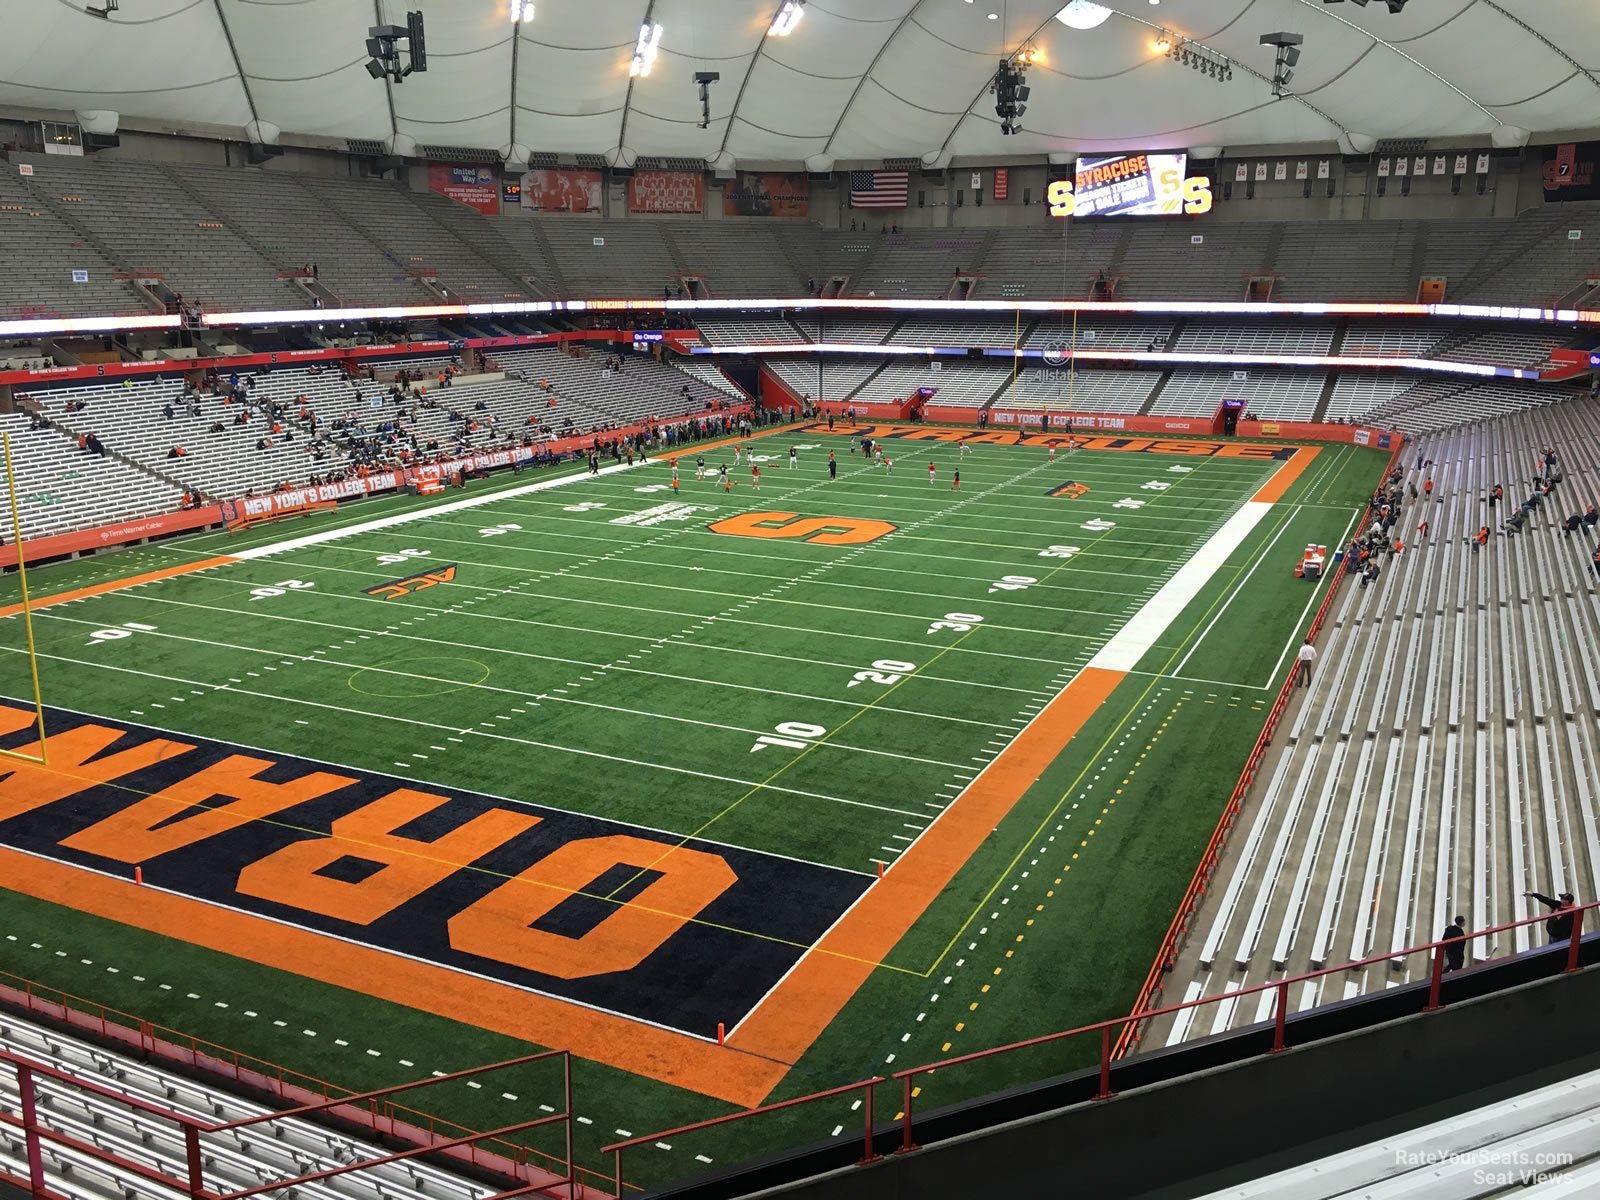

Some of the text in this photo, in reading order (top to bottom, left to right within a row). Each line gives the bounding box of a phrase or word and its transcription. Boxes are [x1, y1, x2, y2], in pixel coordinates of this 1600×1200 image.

[453, 167, 475, 175] United
[462, 175, 475, 183] Way
[1075, 155, 1146, 188] SYRACUSE
[1561, 165, 1568, 175] 7
[1159, 170, 1181, 194] S
[1048, 180, 1075, 216] S
[1184, 176, 1213, 215] S
[587, 301, 627, 309] SYRACUSE
[97, 365, 104, 376] S
[1034, 369, 1079, 380] Allstate
[994, 413, 1015, 423] NEW
[1098, 417, 1125, 429] TEAM
[803, 423, 1284, 459] SYRACUSE
[475, 452, 510, 470] COLLEGE
[512, 447, 533, 462] TEAM
[244, 473, 396, 516] NEW YORK'S COLLEGE TEAM
[222, 503, 234, 521] S
[124, 526, 145, 535] Warner
[145, 522, 163, 530] Cable
[705, 510, 899, 546] S
[1038, 545, 1081, 558] 50
[249, 580, 314, 598] 20
[991, 575, 1037, 591] 40
[90, 622, 158, 641] 10
[929, 612, 984, 632] 30
[853, 659, 916, 685] 20
[756, 721, 827, 749] 10
[0, 704, 740, 980] ORAN
